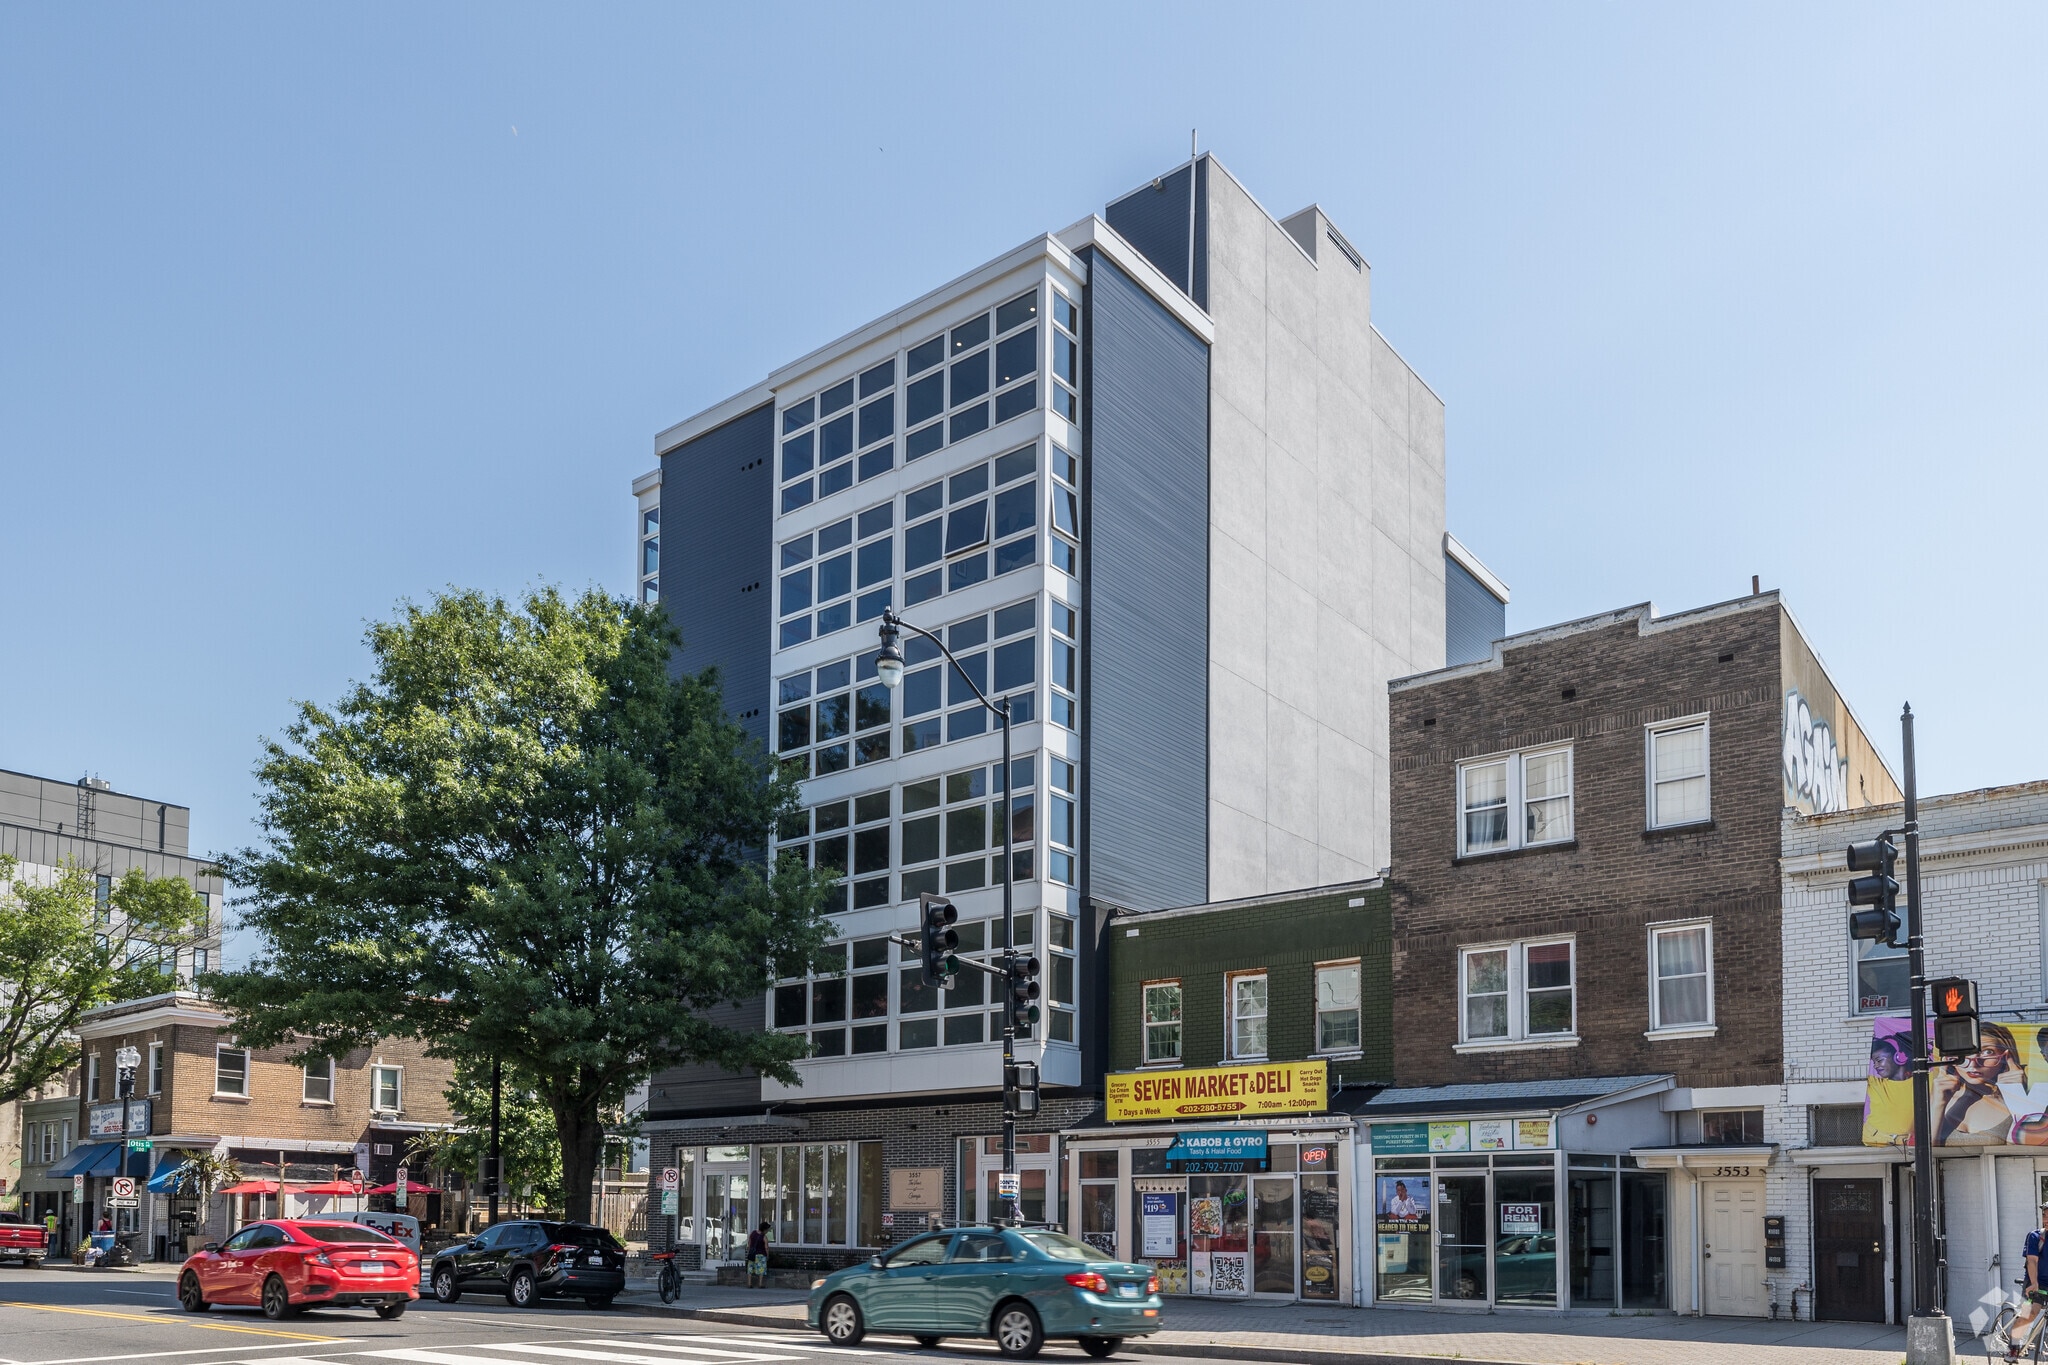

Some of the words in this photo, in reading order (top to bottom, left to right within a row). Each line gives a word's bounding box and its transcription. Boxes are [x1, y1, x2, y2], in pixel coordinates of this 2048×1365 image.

[1861, 996, 1888, 1009] RENT
[1134, 1077, 1181, 1102] SEVEN
[1185, 1073, 1249, 1099] MARKET
[1256, 1069, 1291, 1095] DELI
[1258, 1100, 1283, 1109] 7:00am
[1288, 1099, 1317, 1109] 12:00pm
[1123, 1109, 1138, 1117] Days
[1144, 1107, 1161, 1115] Week
[1186, 1138, 1223, 1147] KABOB
[1224, 1138, 1231, 1146] &
[1233, 1137, 1263, 1146] GYRO
[1303, 1150, 1327, 1161] OPEN
[1185, 1162, 1244, 1172] 202-792-7707
[1713, 1166, 1750, 1177] 3553
[1223, 1190, 1246, 1206] ATM
[1508, 1206, 1533, 1214] FOR
[882, 1215, 894, 1224] FDC
[1504, 1214, 1538, 1222] RENT
[366, 1219, 414, 1239] FedEx
[1377, 1223, 1399, 1232] HEADED
[1399, 1223, 1406, 1232] TO
[1407, 1223, 1418, 1232] THE
[1418, 1223, 1430, 1232] TOP
